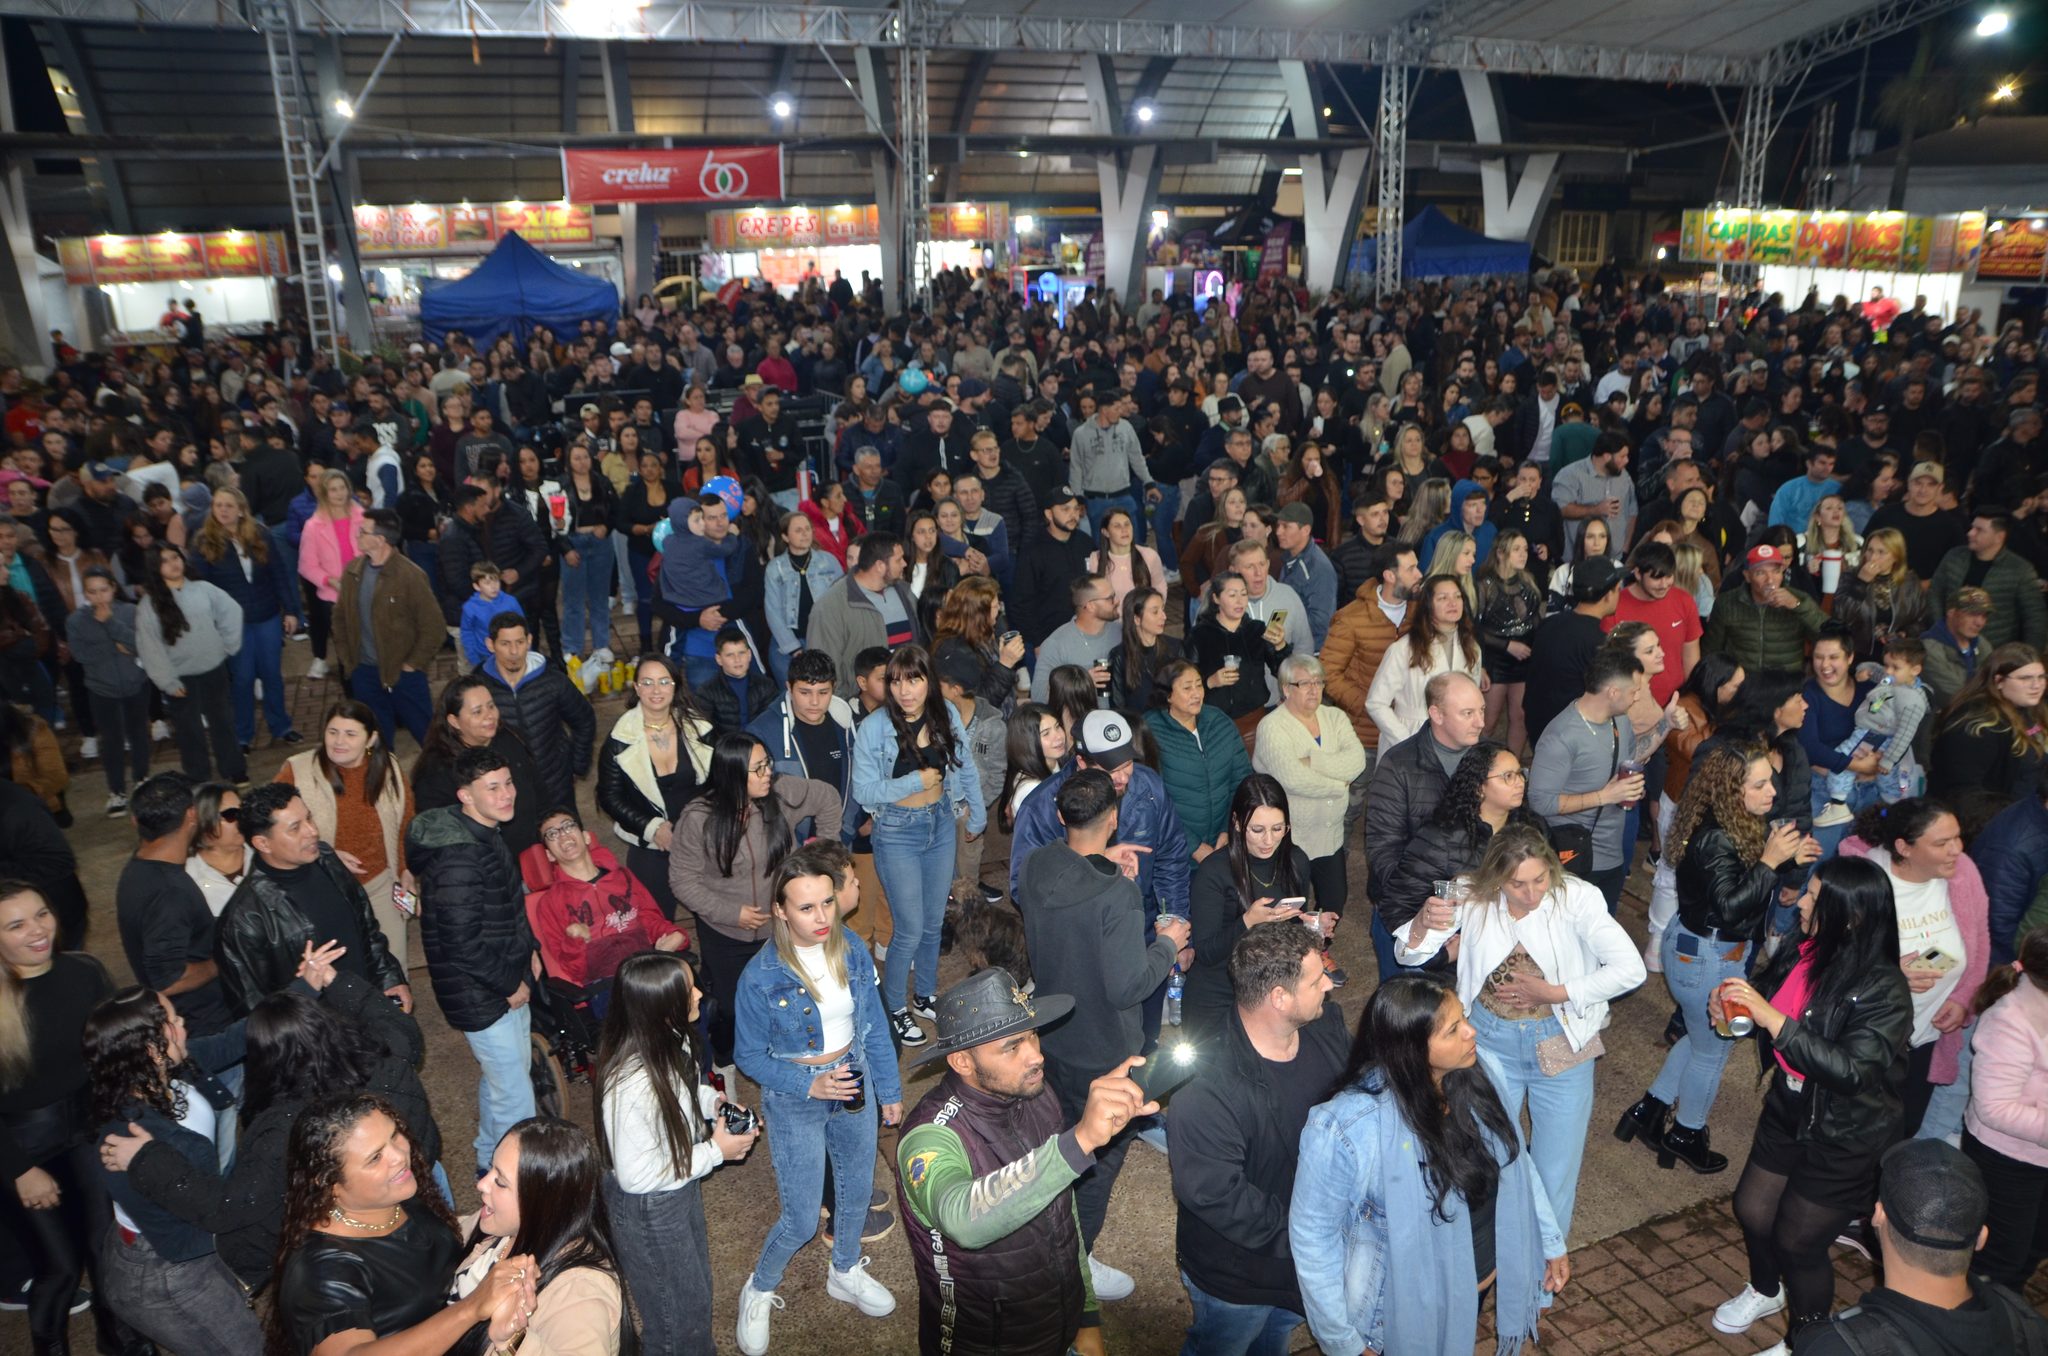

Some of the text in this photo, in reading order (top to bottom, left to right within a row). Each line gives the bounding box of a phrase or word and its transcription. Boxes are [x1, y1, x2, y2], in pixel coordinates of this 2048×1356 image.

[602, 161, 672, 184] creluz
[738, 215, 818, 235] CREPES
[1799, 220, 1903, 251] DRINKS
